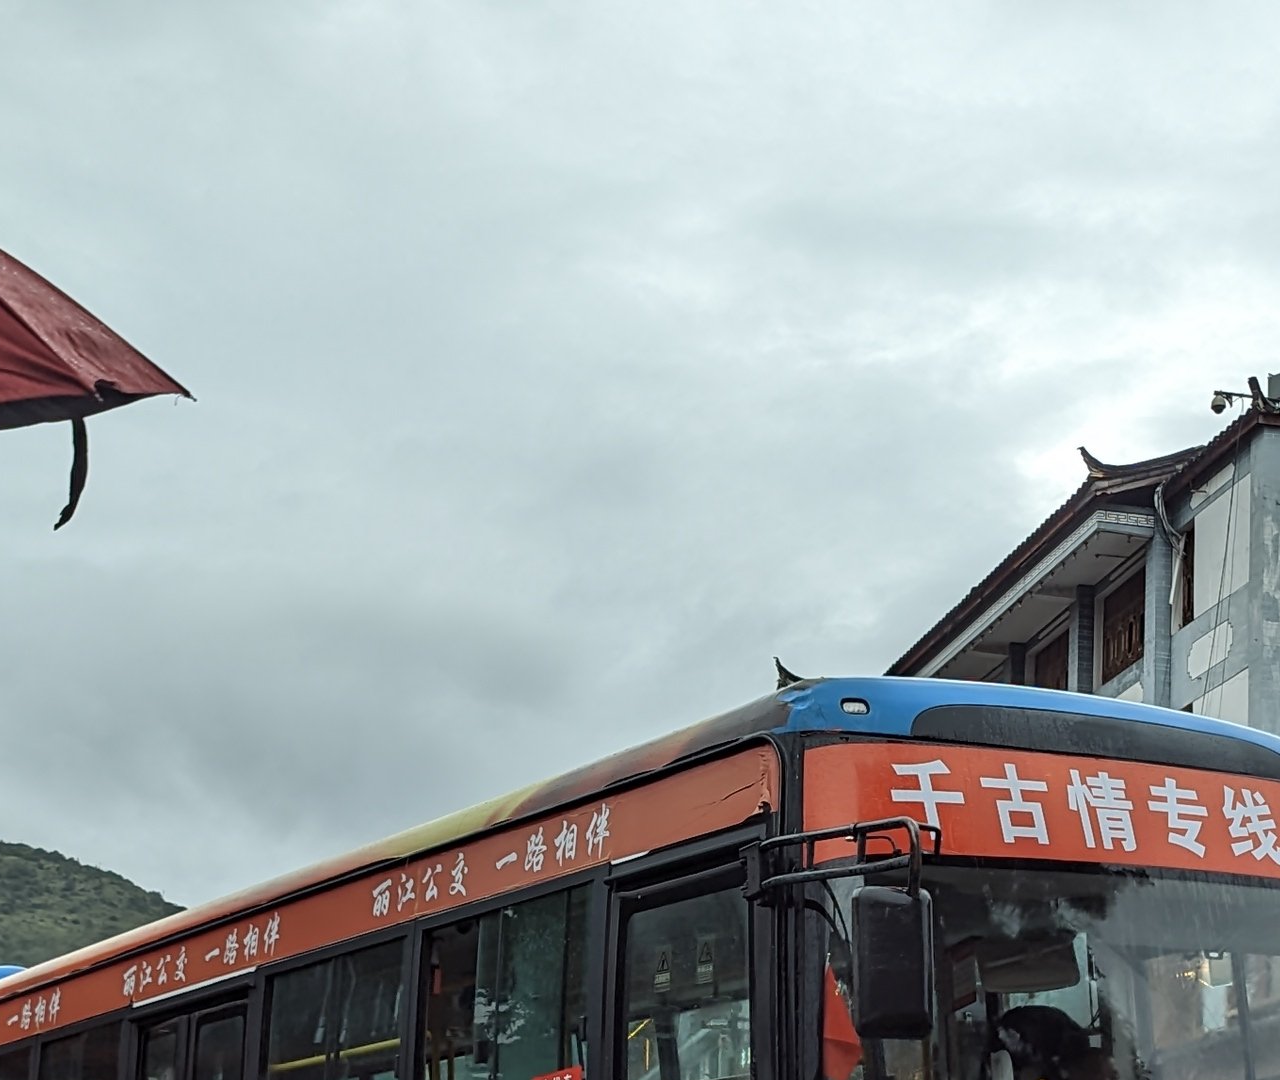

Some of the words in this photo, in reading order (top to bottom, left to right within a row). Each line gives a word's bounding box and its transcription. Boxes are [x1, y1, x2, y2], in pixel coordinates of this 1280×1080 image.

[371, 850, 469, 918] 丽江公交
[494, 803, 612, 872] 一路相伴
[122, 946, 189, 998] 丽江公交
[203, 911, 282, 966] 一路相伴
[6, 986, 62, 1031] 一路相伴
